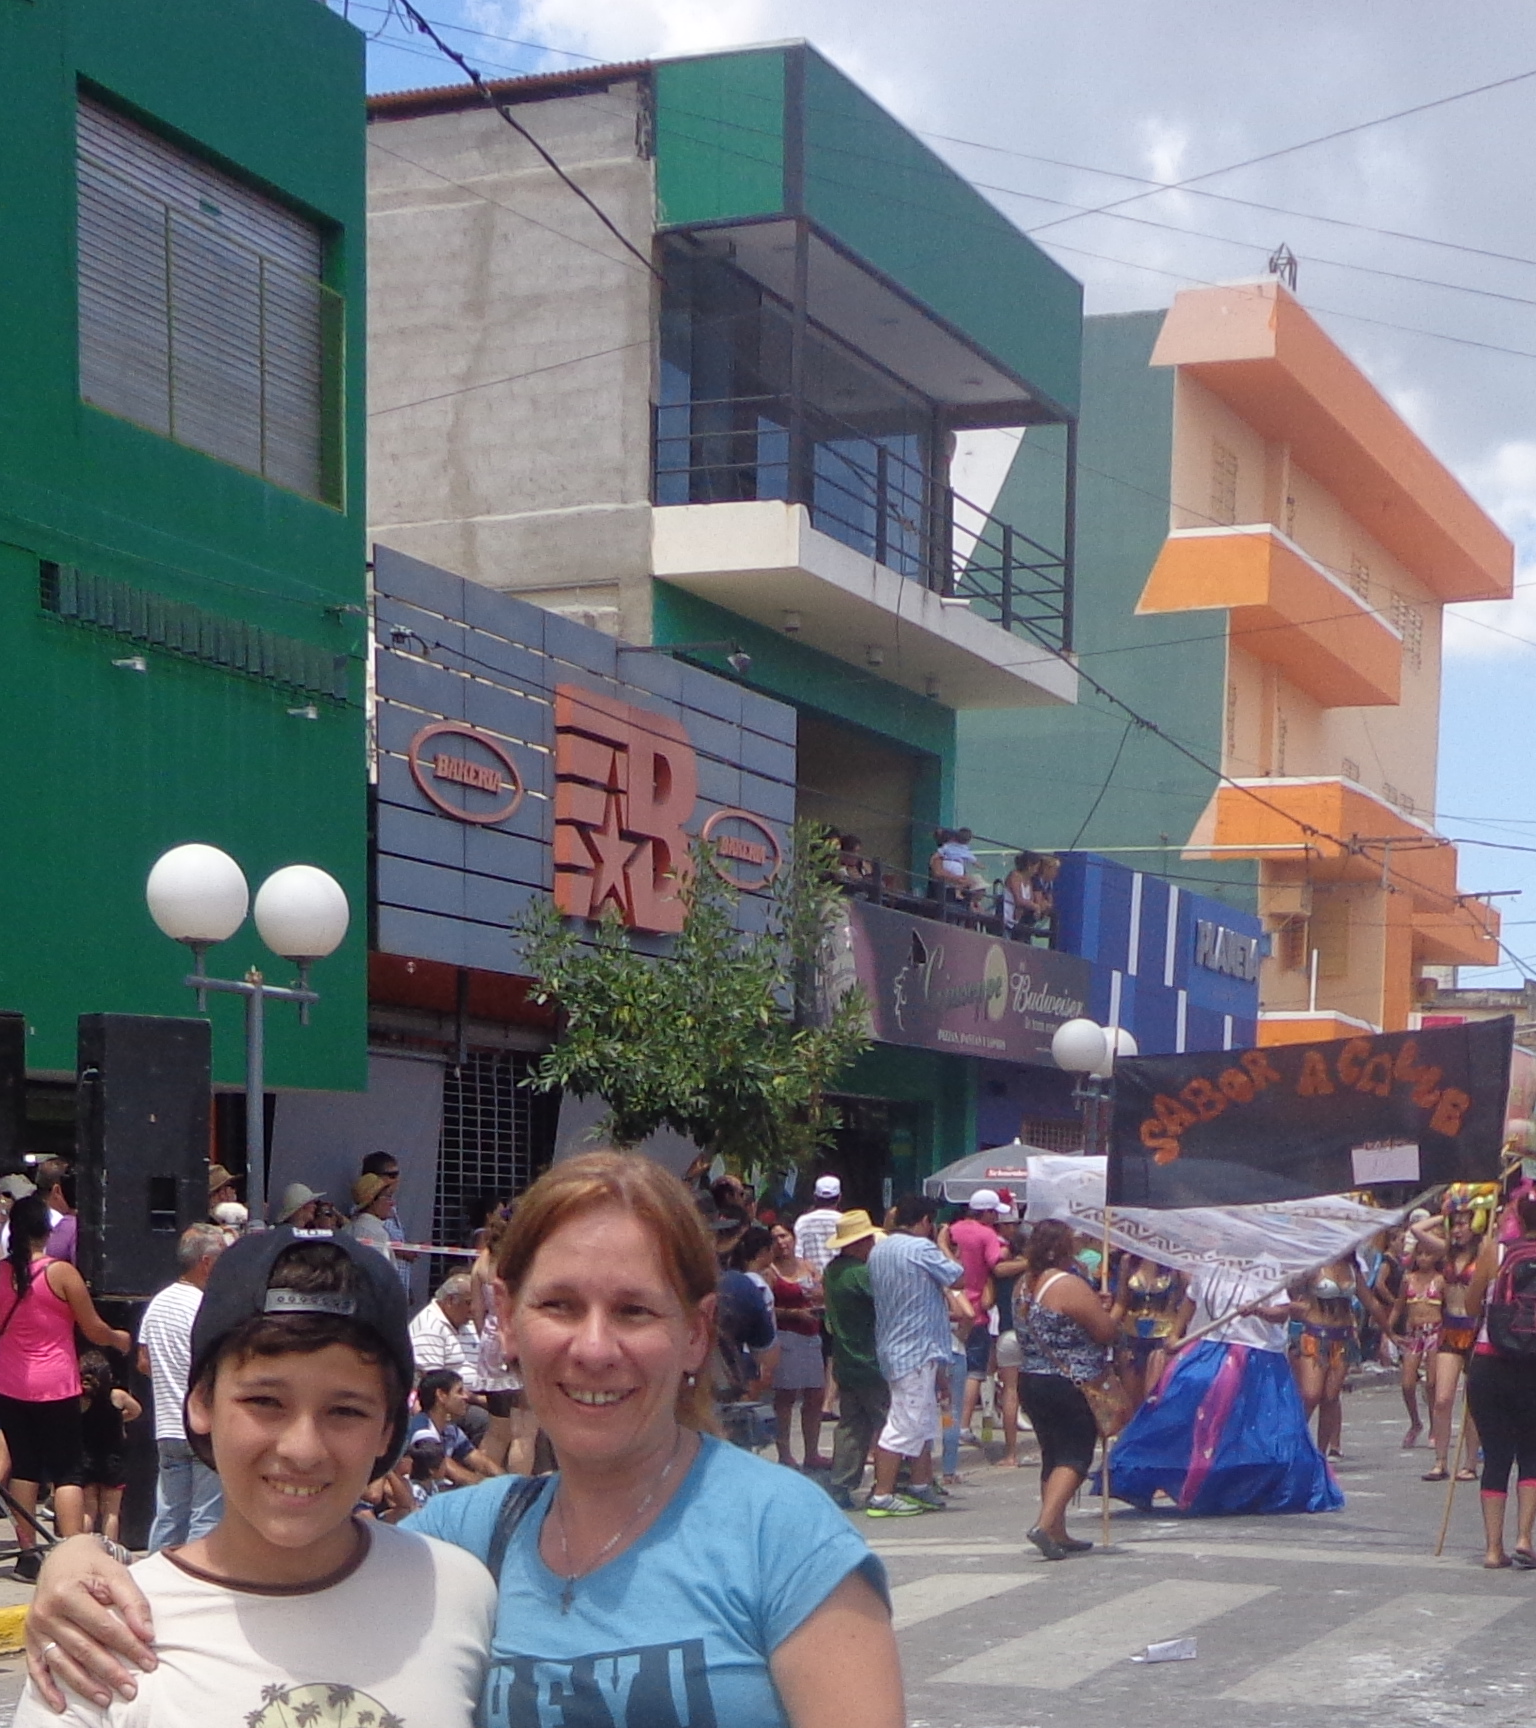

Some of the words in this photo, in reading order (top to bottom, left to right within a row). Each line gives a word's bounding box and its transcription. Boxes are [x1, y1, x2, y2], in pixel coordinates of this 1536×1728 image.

[434, 753, 502, 794] BAKERIA
[1010, 972, 1084, 1018] Budweiser
[1139, 1049, 1283, 1166] SABOR
[1295, 1051, 1337, 1097] A
